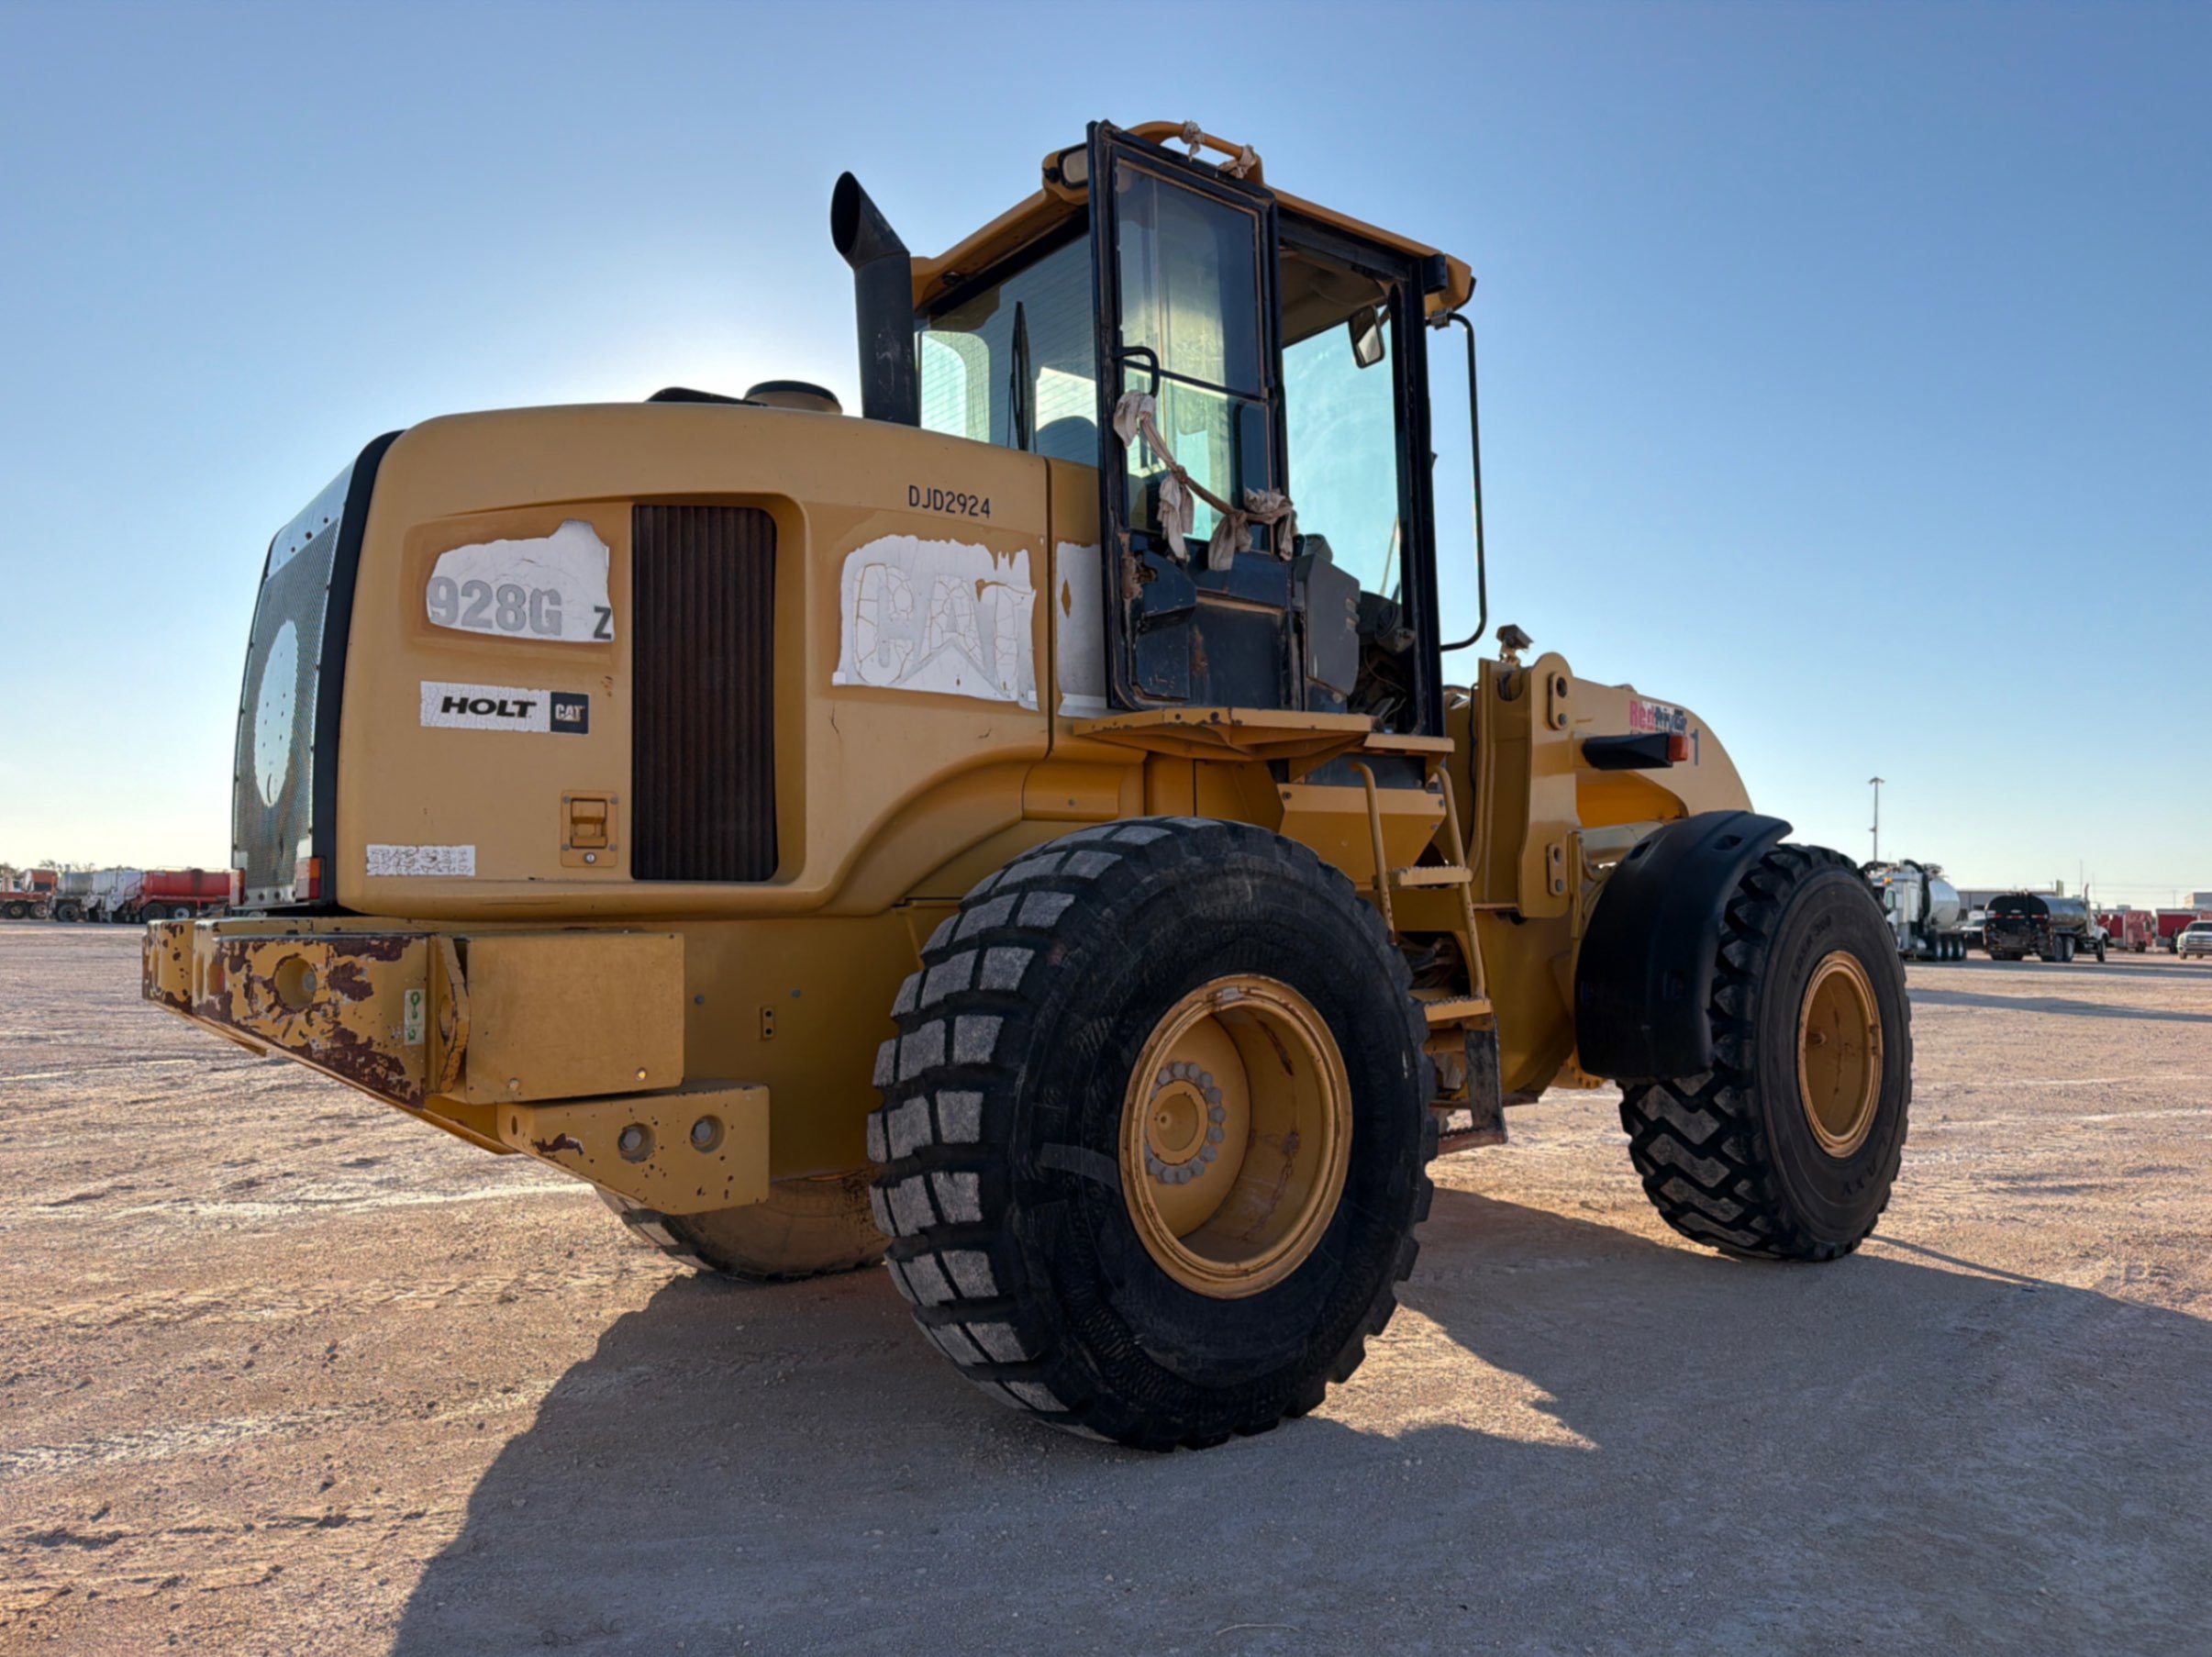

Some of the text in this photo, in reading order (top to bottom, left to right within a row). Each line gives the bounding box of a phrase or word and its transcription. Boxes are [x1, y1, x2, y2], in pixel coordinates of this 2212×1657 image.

[907, 484, 991, 519] DJD2924
[428, 575, 562, 637] 928G
[440, 695, 583, 723] HOLT CAT
